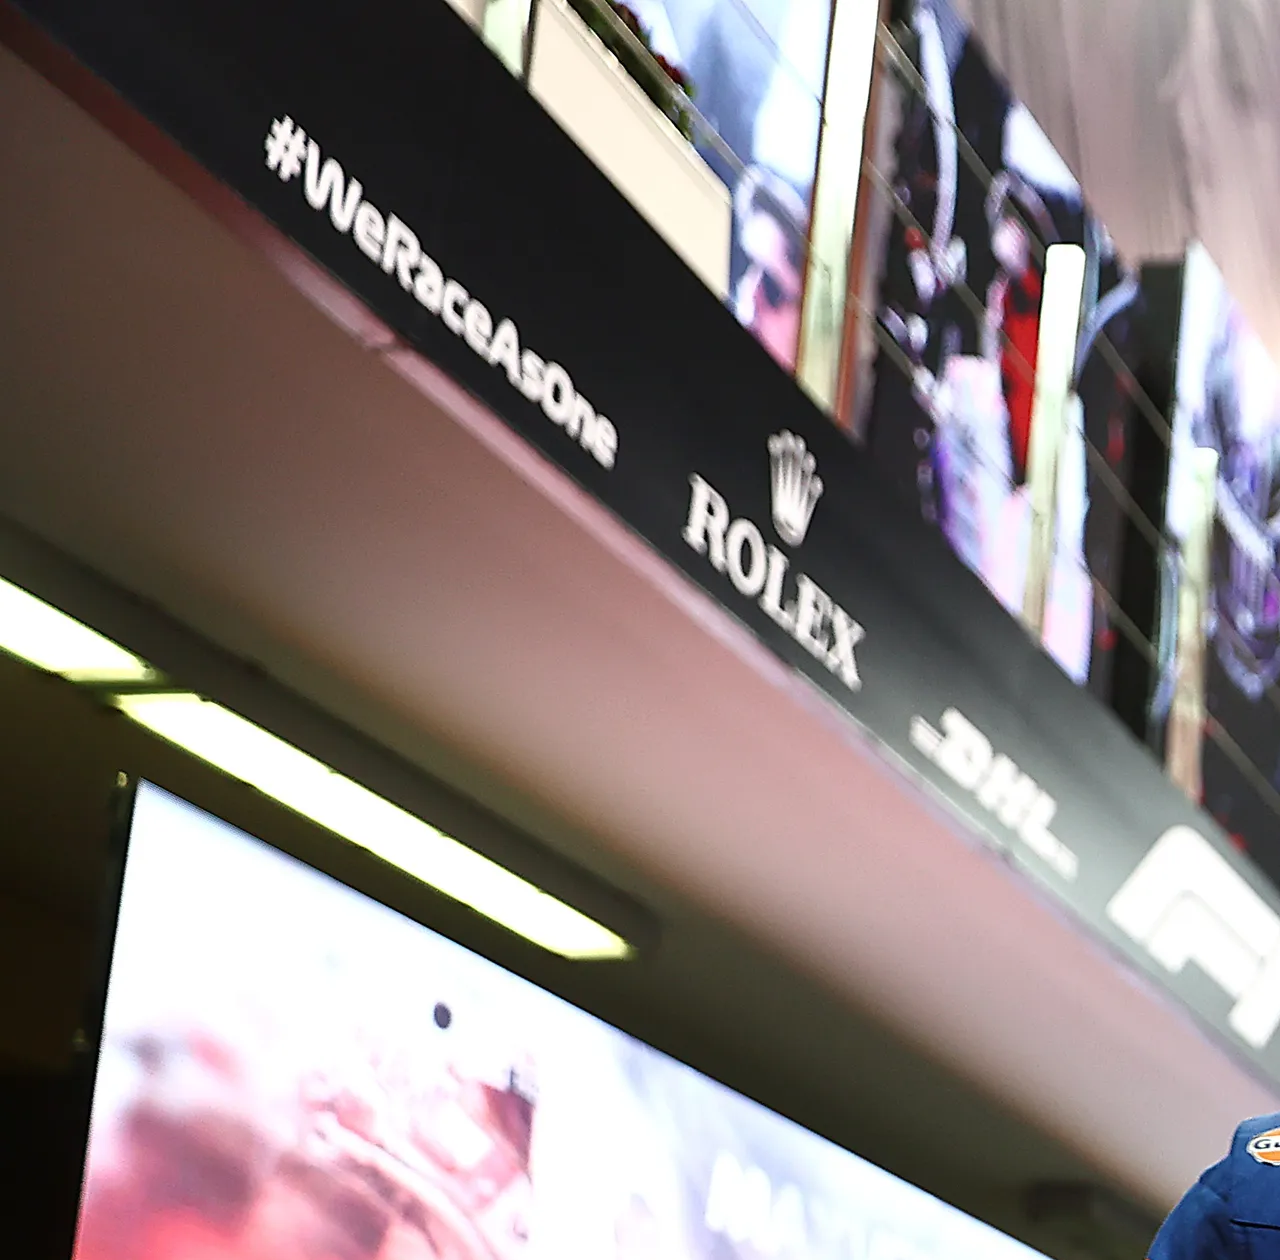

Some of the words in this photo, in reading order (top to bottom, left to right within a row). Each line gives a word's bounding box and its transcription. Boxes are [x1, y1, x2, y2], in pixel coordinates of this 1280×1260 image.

[264, 113, 619, 470] #WeRaceAsOne
[682, 471, 866, 692] ROLEX
[909, 707, 1078, 883] DHL
